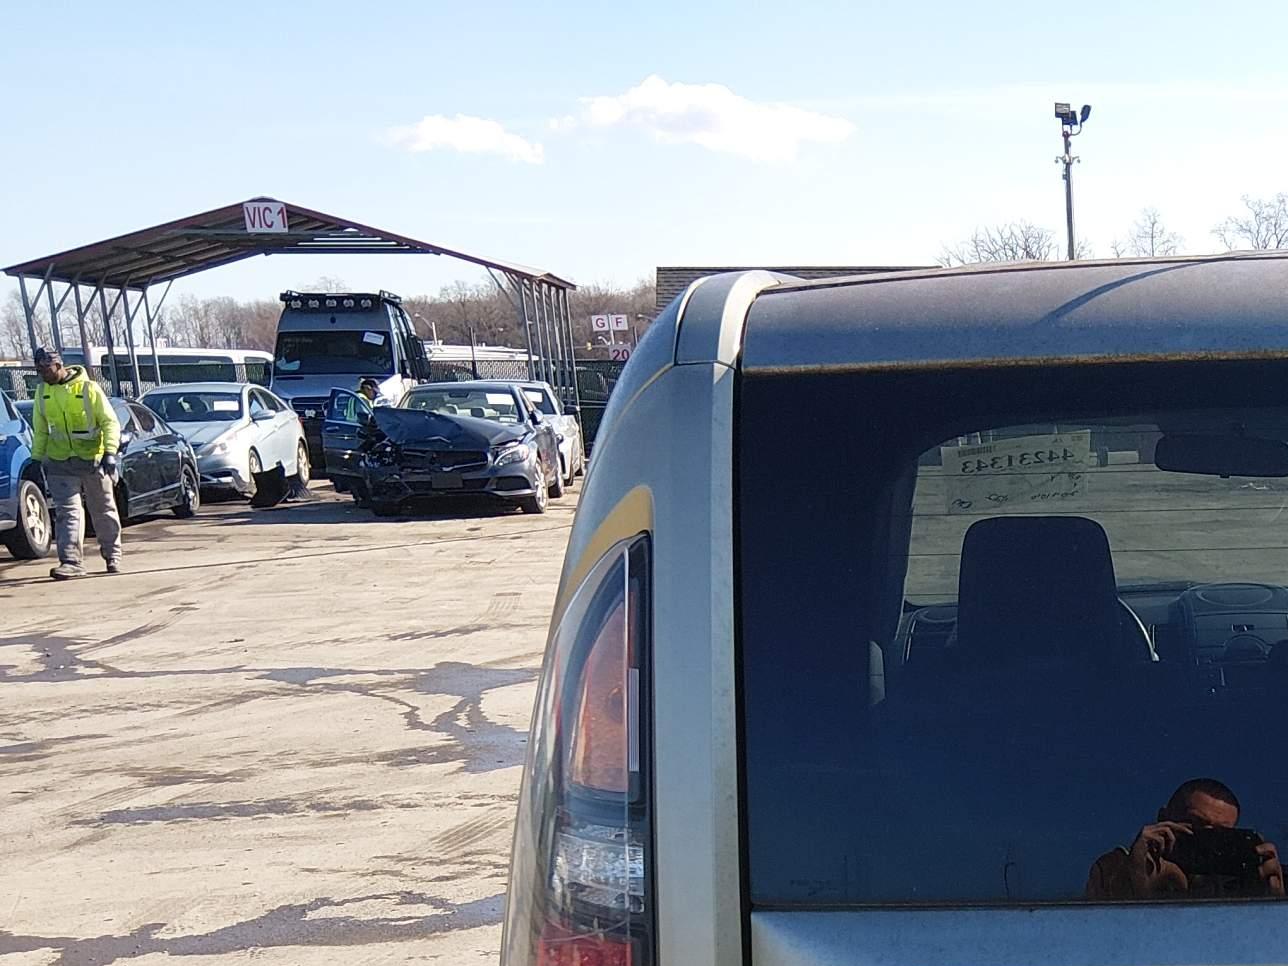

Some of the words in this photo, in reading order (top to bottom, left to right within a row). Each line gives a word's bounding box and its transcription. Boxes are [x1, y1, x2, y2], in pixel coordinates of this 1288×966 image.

[245, 206, 274, 229] VIC
[277, 206, 287, 229] 1
[595, 317, 606, 329] G
[615, 316, 623, 328] F
[612, 349, 630, 361] 20
